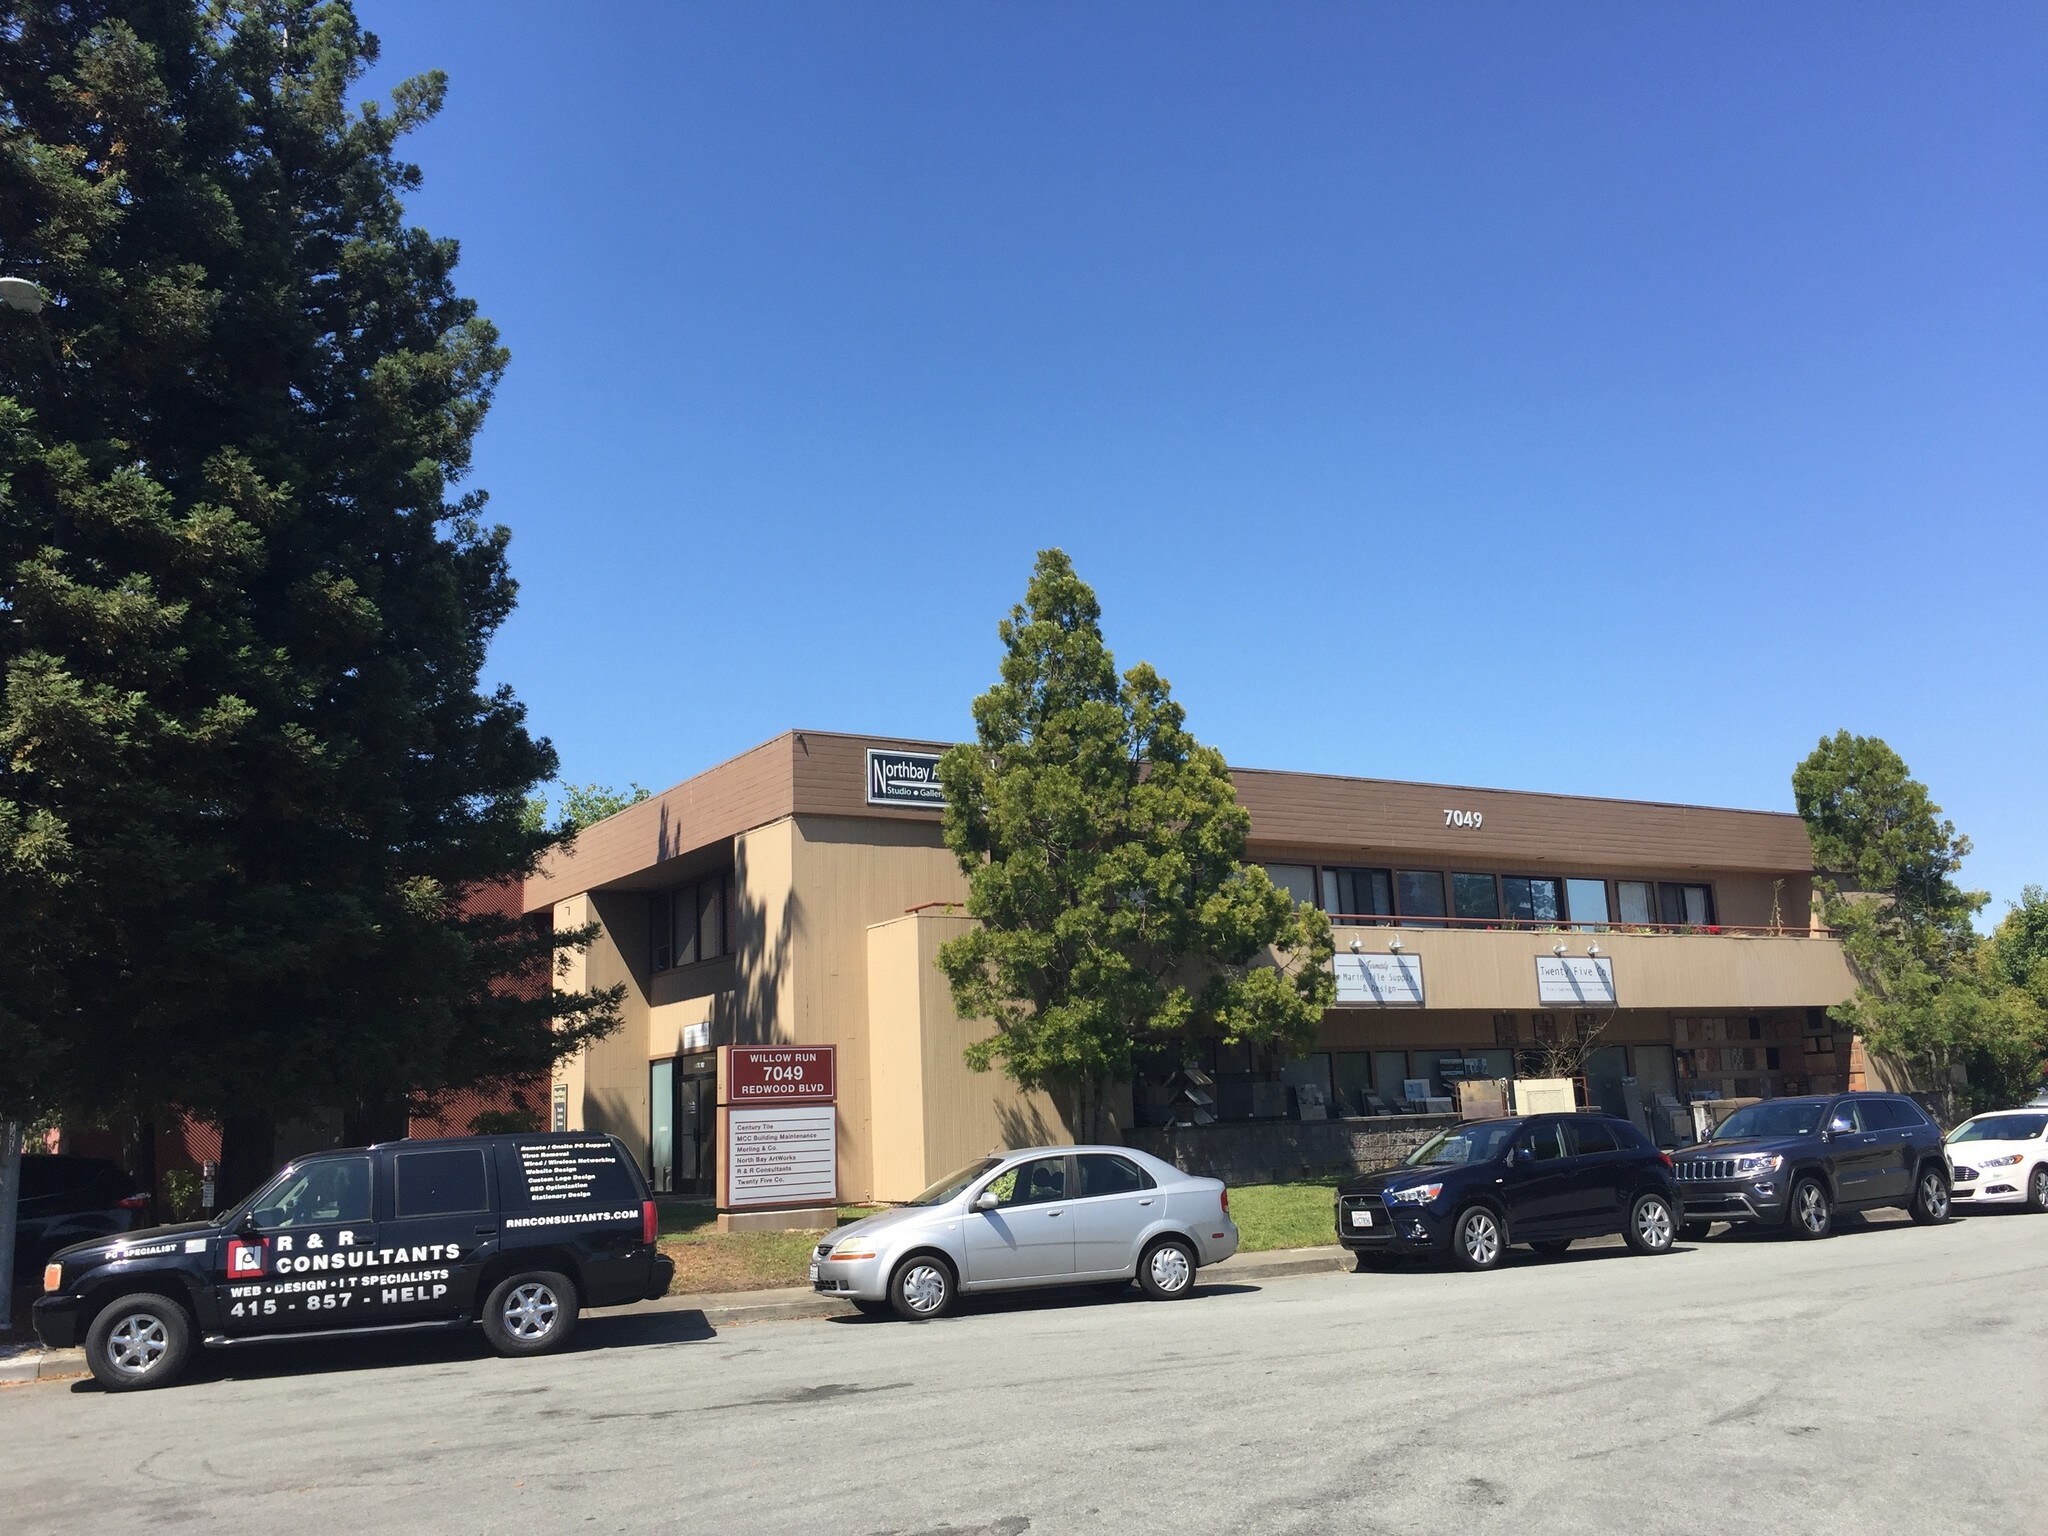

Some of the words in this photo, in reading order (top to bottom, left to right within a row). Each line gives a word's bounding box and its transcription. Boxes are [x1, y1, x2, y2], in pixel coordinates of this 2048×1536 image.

[874, 759, 930, 793] Northbay
[887, 786, 912, 796] Studio
[919, 789, 945, 799] Gallery
[1443, 809, 1483, 828] 7049
[1342, 973, 1365, 981] Marin
[1368, 973, 1385, 981] Tile
[1389, 973, 1413, 982] Supply
[1540, 966, 1569, 978] Twenty
[1573, 967, 1593, 976] Five
[1597, 966, 1610, 976] Co.
[1362, 984, 1368, 992] &
[1371, 984, 1397, 993] Design
[750, 1053, 792, 1062] WILLOW
[795, 1053, 816, 1062] RUN
[763, 1065, 803, 1081] 7049
[741, 1084, 795, 1094] REDWOOD
[798, 1083, 824, 1093] BLVD
[756, 1166, 792, 1174] Consultants
[545, 1182, 588, 1191] Optimization
[531, 1193, 567, 1201] Stationary
[506, 1210, 638, 1228] RNRCONSULTANTS.COM
[277, 1235, 293, 1251] R
[306, 1233, 324, 1249] &
[338, 1230, 355, 1246] R
[123, 1244, 177, 1257] SPECIALIST
[276, 1243, 460, 1274] CONSULTANTS
[230, 1286, 262, 1298] WEB
[274, 1280, 327, 1295] DESIGN
[361, 1269, 449, 1287] SPECIALISTS
[230, 1299, 277, 1318] 415
[307, 1293, 352, 1311] 857
[382, 1284, 448, 1304] HELP
